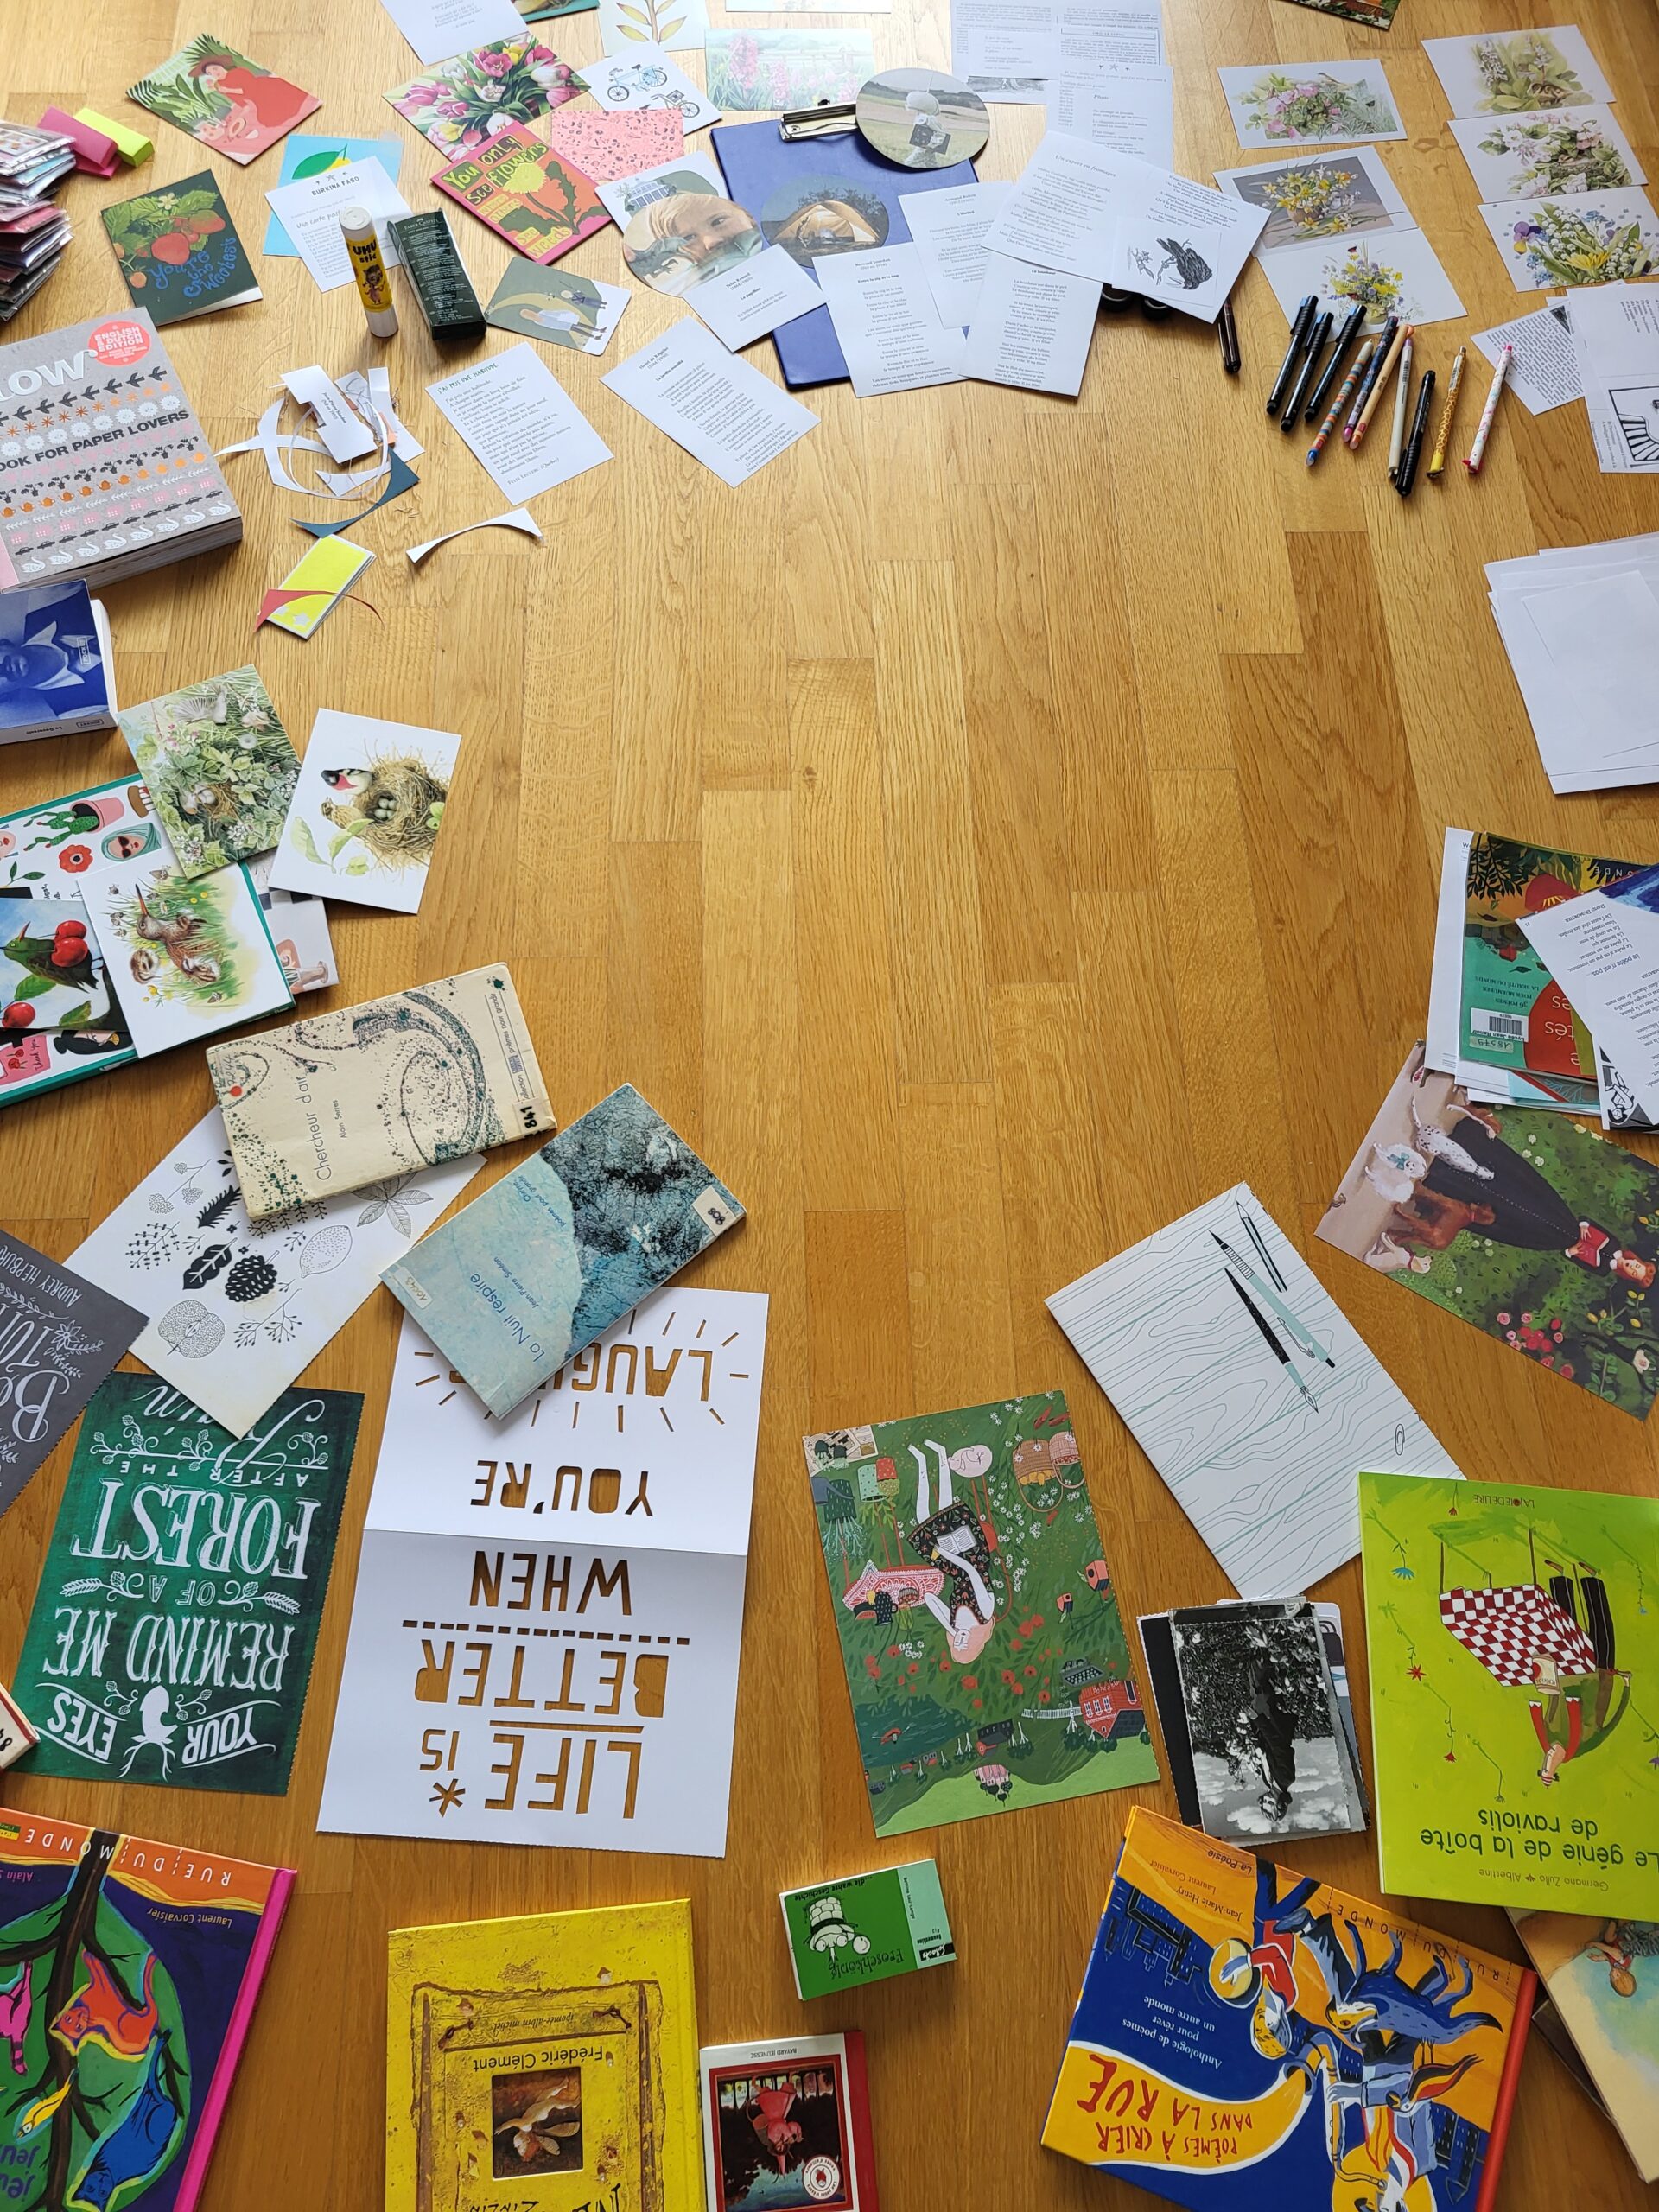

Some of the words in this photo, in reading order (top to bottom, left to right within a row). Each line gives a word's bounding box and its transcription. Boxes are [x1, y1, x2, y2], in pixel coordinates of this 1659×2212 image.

[487, 143, 548, 186] flowers
[311, 183, 340, 196] BURKINA
[341, 176, 359, 186] FASO
[442, 166, 480, 189] You
[353, 239, 377, 255] UHU
[94, 327, 140, 340] ENGLISH
[106, 333, 142, 344] DUTCH
[99, 340, 143, 352] EDITION
[35, 445, 69, 462] FOR
[72, 429, 124, 452] PAPER
[128, 410, 189, 435] LOVERS
[1604, 961, 1617, 972] n'est
[1617, 956, 1633, 965] poète
[294, 1074, 312, 1104] d'air
[333, 1099, 342, 1120] Serres
[520, 1106, 538, 1128] 841
[306, 1112, 333, 1181] Chercheur
[0, 1245, 41, 1285] HEPBUR
[41, 1274, 82, 1308] AUDREY
[469, 1273, 504, 1316] respire
[502, 1313, 530, 1346] Nuit
[528, 1342, 545, 1363] La
[120, 1460, 178, 1477] THE
[208, 1467, 309, 1489] AFTER
[470, 1459, 654, 1517] YOU'RE
[69, 1478, 321, 1580] FOREST
[149, 1575, 168, 1604] A
[175, 1579, 216, 1607] OF
[468, 1550, 632, 1616] WHEN
[42, 1606, 118, 1679] ME
[126, 1613, 296, 1693] REMIND
[413, 1638, 669, 1719] BETTER
[47, 1690, 117, 1761] EYES
[181, 1706, 259, 1765] YOUR
[418, 1728, 460, 1772] IS
[484, 1732, 643, 1820] LIFE
[1478, 1809, 1560, 1834] raviolis
[1571, 1819, 1599, 1840] de
[25, 1828, 116, 1860] MONDE
[1421, 1828, 1483, 1855] boîte
[1493, 1836, 1514, 1859] la
[1524, 1840, 1552, 1861] de
[133, 1852, 166, 1872] DU
[1206, 1848, 1235, 1872] Poésie
[1562, 1843, 1624, 1870] génie
[7, 1869, 34, 1883] Alain
[184, 1865, 233, 1886] RUE
[1148, 1859, 1187, 1885] Corvaisier
[1235, 1863, 1253, 1877] La
[1478, 1868, 1522, 1883] Albertine
[1539, 1875, 1561, 1888] Zullo
[794, 1887, 830, 1902] Geschichte
[831, 1880, 854, 1892] wahre
[1175, 1885, 1202, 1906] Henry
[1186, 1873, 1217, 1895] Laurent
[1565, 1878, 1609, 1891] Germano
[146, 1906, 196, 1924] Corvaisier
[1201, 1894, 1243, 1922] Jean-Marie
[197, 1915, 233, 1929] Laurent
[1337, 1904, 1408, 1943] MONDE
[828, 1949, 905, 1980] Froschkönig
[1462, 1957, 1501, 1982] RUE
[1142, 1994, 1172, 2018] monde
[1151, 2014, 1175, 2033] rêver
[1172, 2008, 1198, 2030] autre
[1198, 2018, 1217, 2032] un
[1122, 2018, 1157, 2044] poèmes
[1157, 2033, 1172, 2049] de
[1175, 2024, 1200, 2042] pour
[473, 2053, 536, 2073] Clément
[541, 2045, 603, 2065] Frédéric
[750, 2050, 776, 2058] JEUNESSE
[1171, 2037, 1224, 2070] Anthologie
[1077, 2053, 1160, 2125] RUE
[1172, 2102, 1202, 2131] LA
[1210, 2111, 1254, 2133] DANS
[1094, 2120, 1154, 2155] CRIER
[1161, 2133, 1177, 2161] À
[1184, 2136, 1238, 2157] POÈMES
